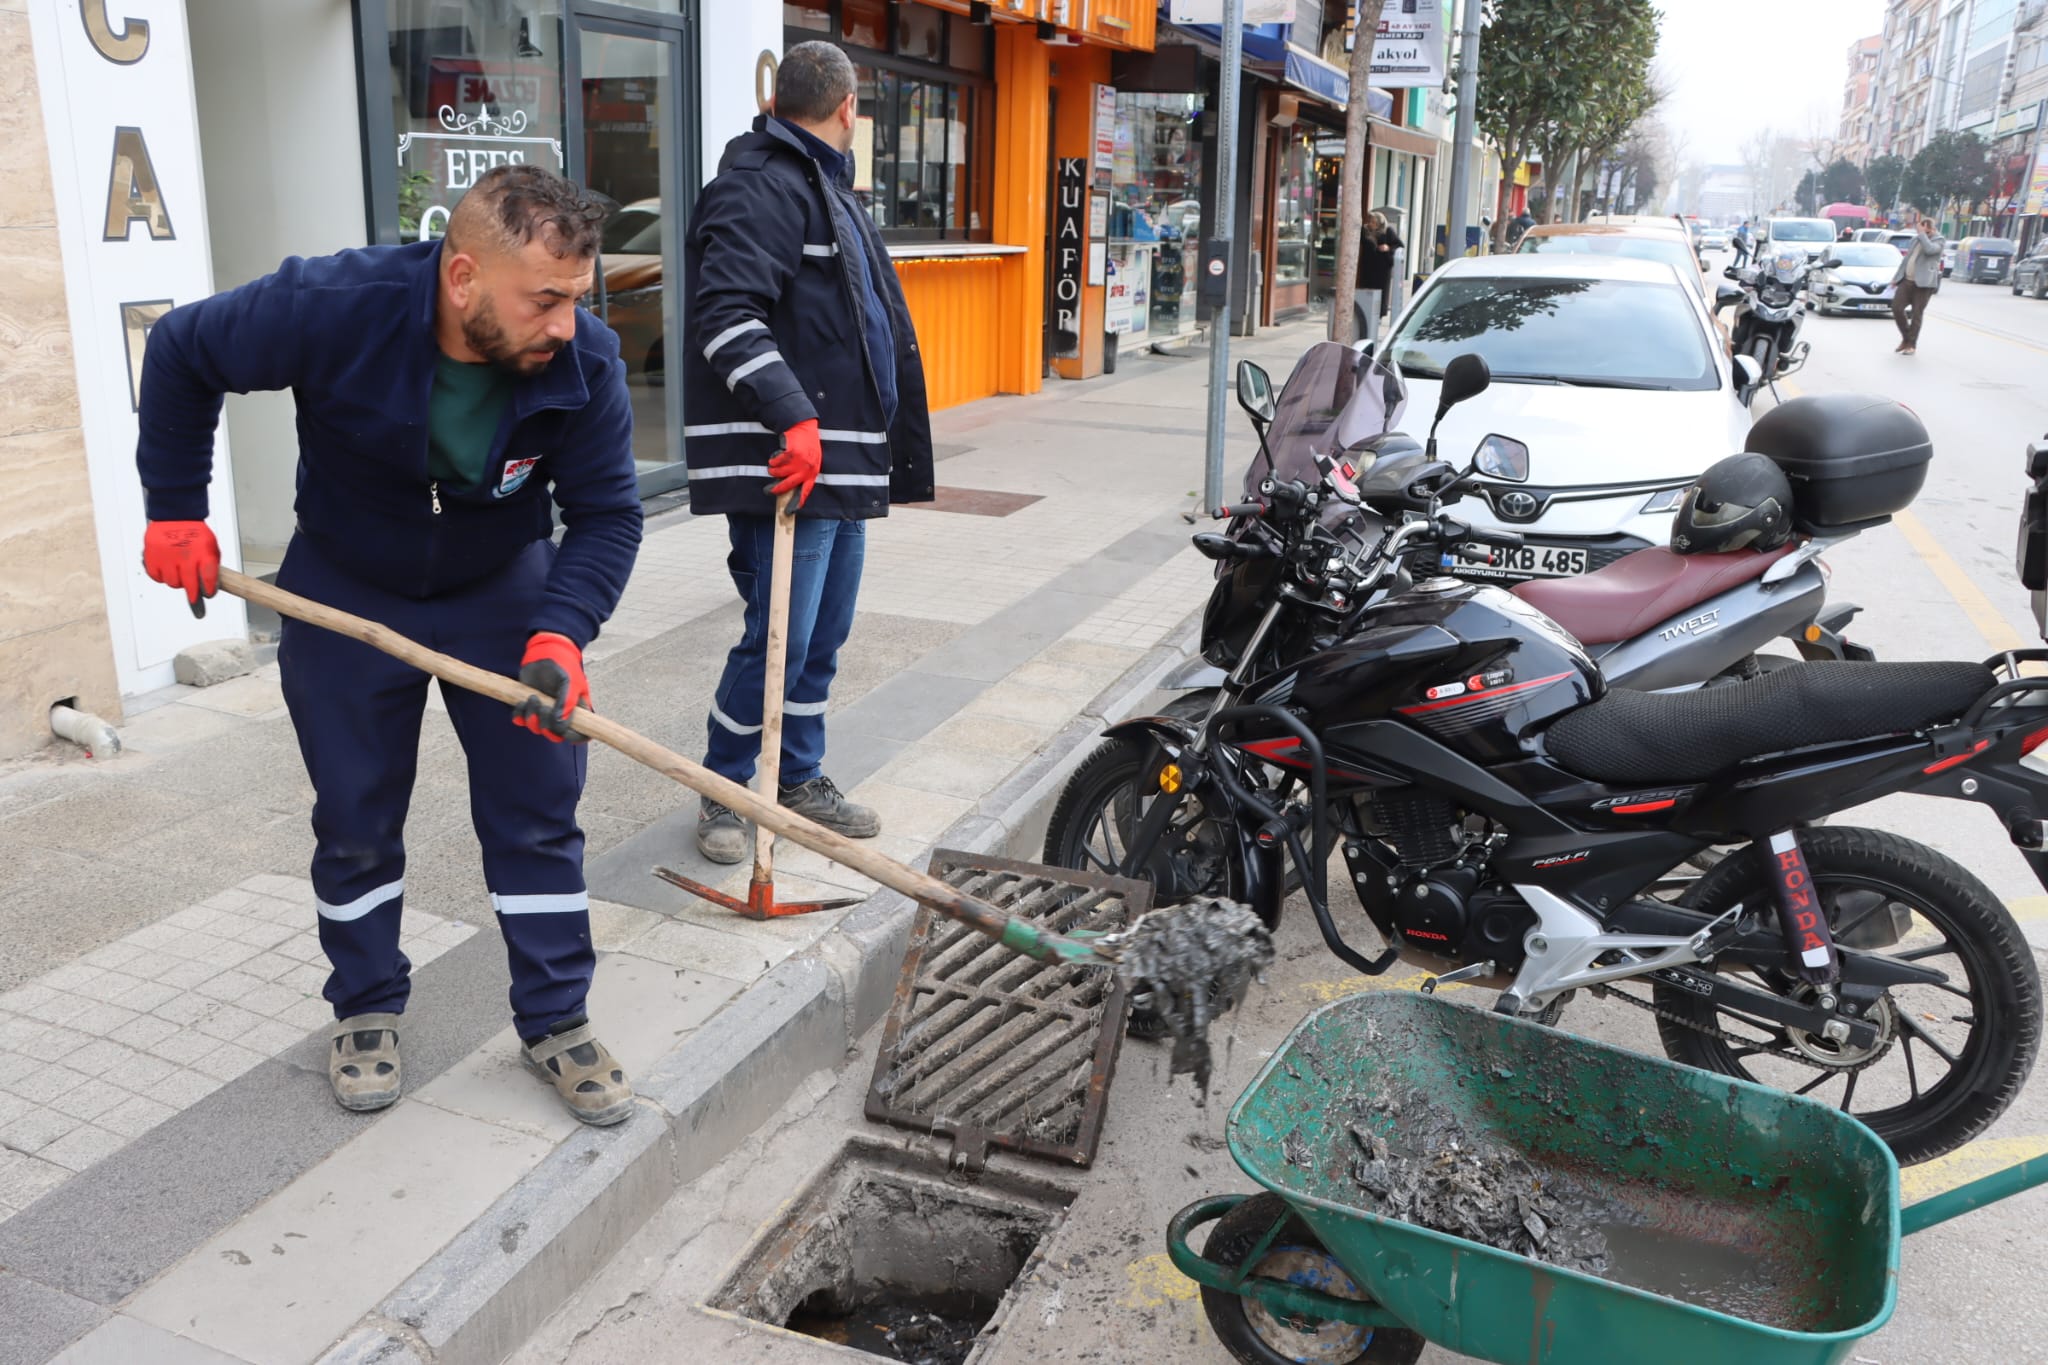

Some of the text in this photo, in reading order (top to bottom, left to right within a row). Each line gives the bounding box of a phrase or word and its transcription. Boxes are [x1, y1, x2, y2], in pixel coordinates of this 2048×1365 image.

[1377, 48, 1417, 62] akyol
[1490, 546, 1535, 570] BKB
[1541, 550, 1585, 574] 485
[1453, 567, 1506, 578] AKKOYUNLU
[1659, 607, 1720, 641] TWEET
[1778, 849, 1826, 952] HONDA
[1406, 928, 1448, 941] HONDA
